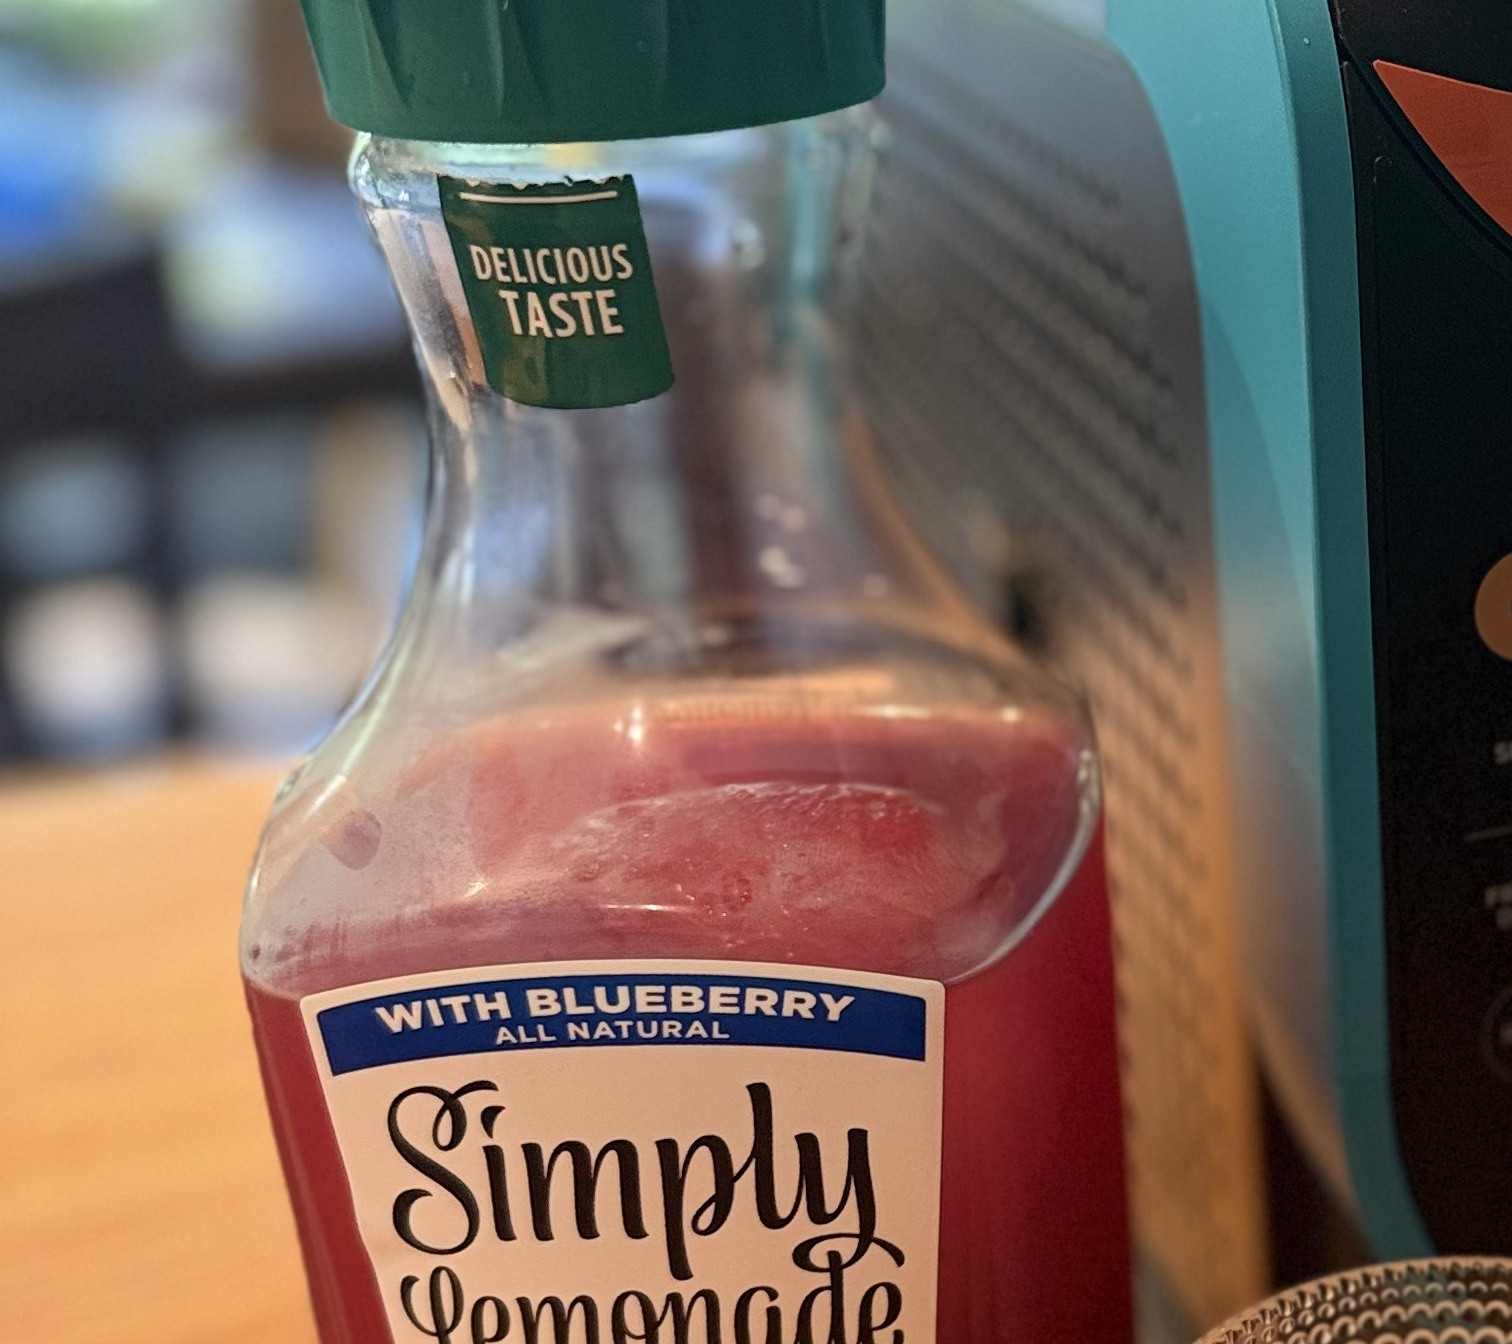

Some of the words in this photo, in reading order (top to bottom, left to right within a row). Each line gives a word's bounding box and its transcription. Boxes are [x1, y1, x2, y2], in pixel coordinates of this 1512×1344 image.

[468, 243, 634, 285] DELICIOUS
[499, 288, 625, 339] TASTE
[375, 991, 512, 1035] WITH
[525, 985, 857, 1023] BLUEBERRY
[495, 1024, 557, 1046] ALL
[568, 1019, 731, 1041] NATURAL
[387, 1080, 906, 1281] Simply
